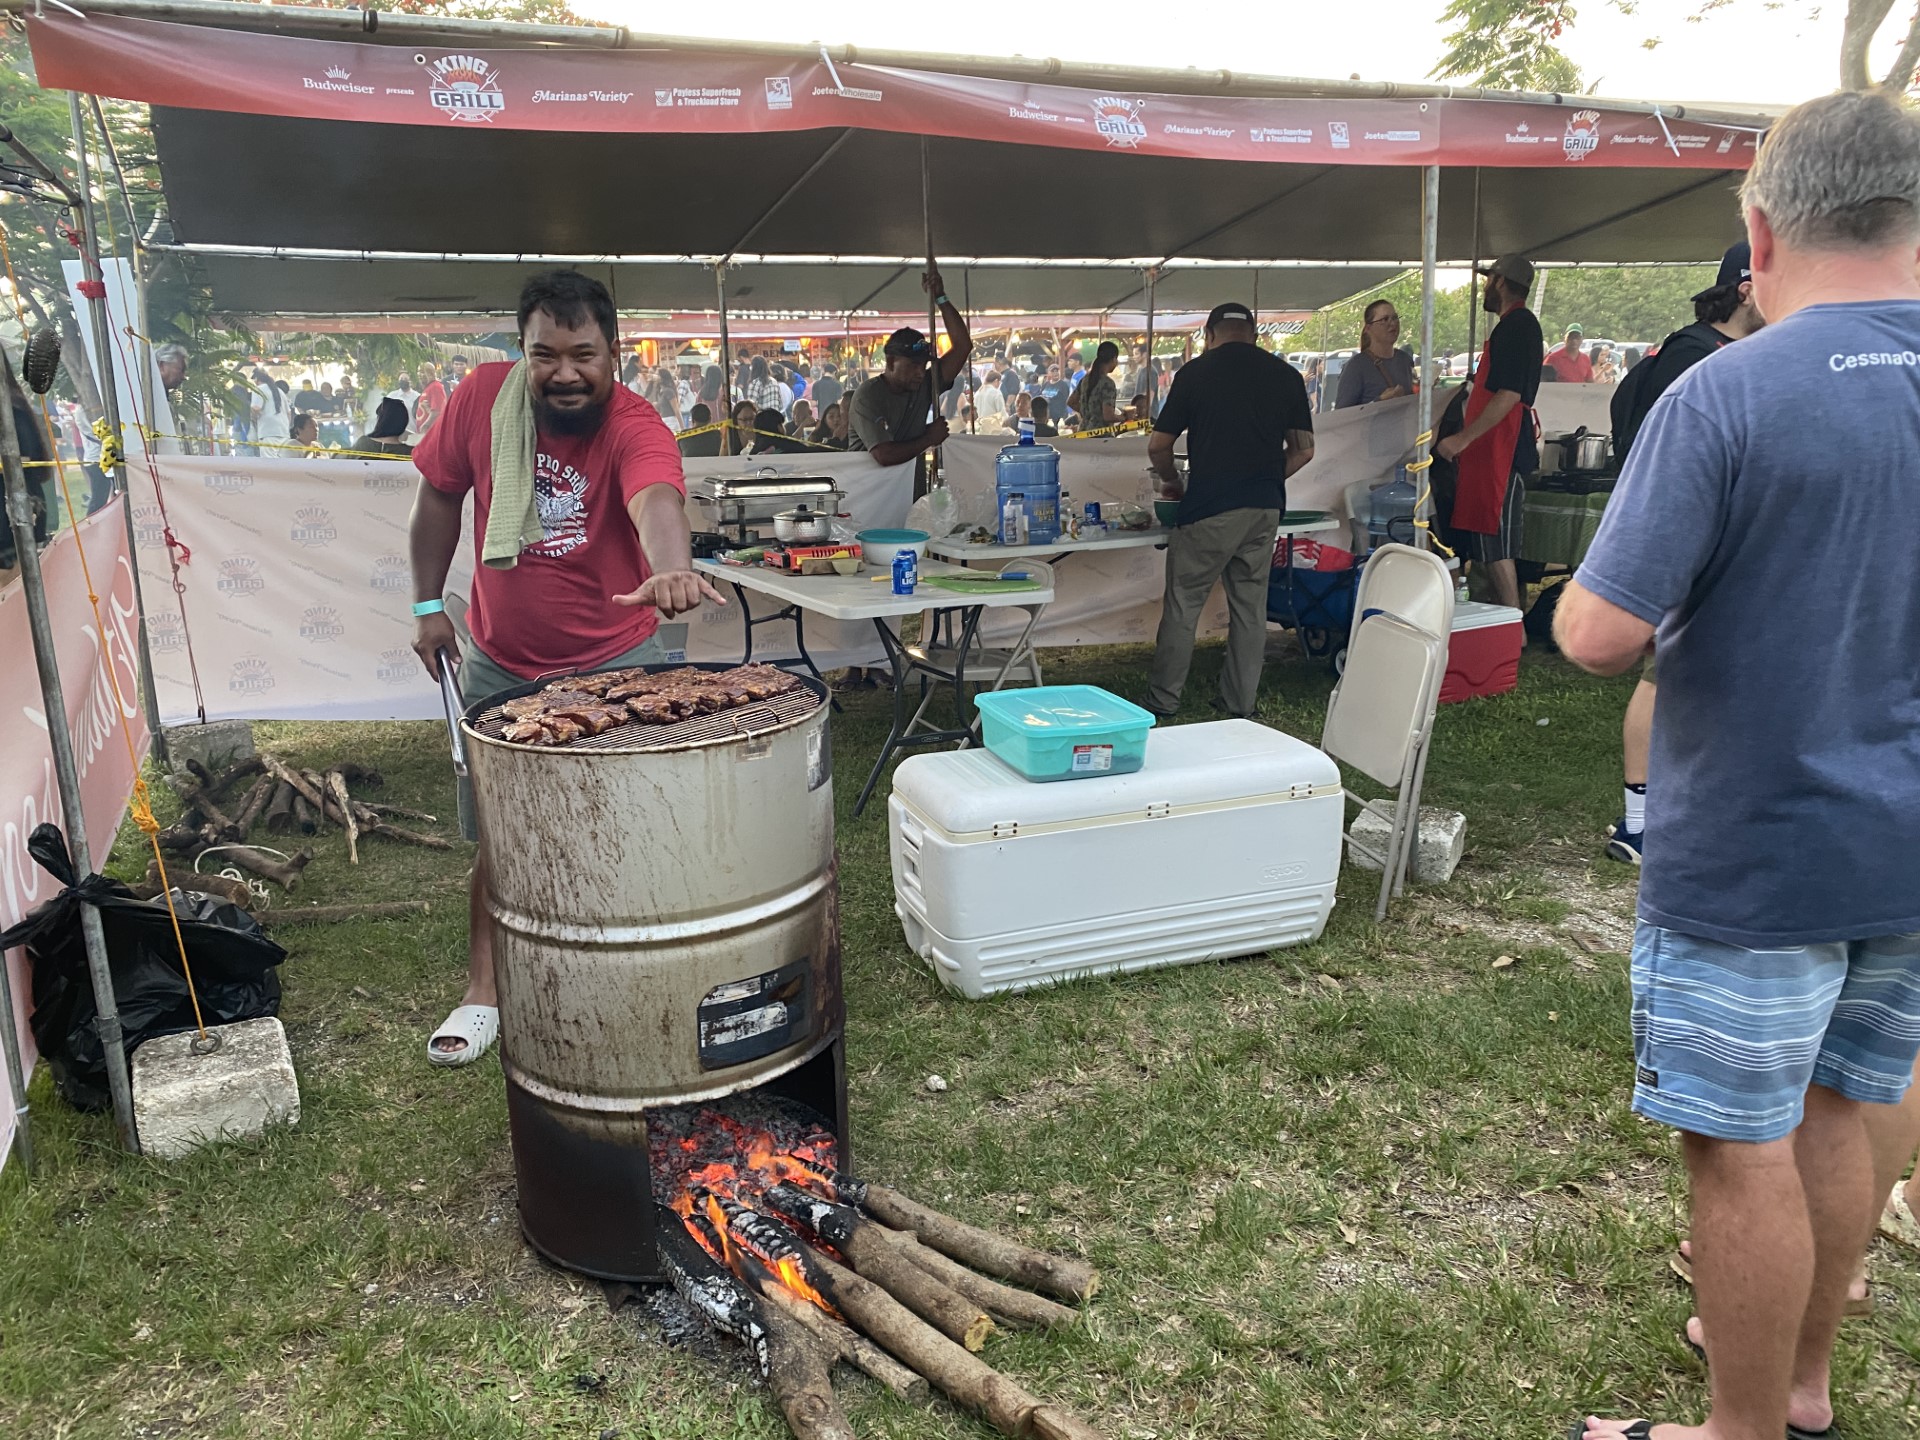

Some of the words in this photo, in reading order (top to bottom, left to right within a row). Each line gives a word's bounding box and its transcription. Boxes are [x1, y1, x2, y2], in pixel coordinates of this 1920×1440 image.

[433, 55, 488, 75] KING
[303, 77, 375, 95] Budweiser
[386, 87, 415, 95] presents
[673, 88, 700, 97] Payless
[812, 87, 839, 96] Joeten
[433, 92, 503, 109] GRILL
[532, 90, 588, 103] Marianas
[588, 90, 634, 104] Variety
[677, 98, 683, 106] &
[684, 98, 719, 106] Truckload
[720, 98, 739, 106] Store
[1092, 97, 1132, 112] KING
[1009, 107, 1059, 122] Budweiser
[1572, 110, 1601, 123] KING
[1098, 121, 1146, 136] GRILL
[1164, 124, 1204, 135] Marianas
[1203, 126, 1236, 138] Variety
[1564, 138, 1596, 150] GRILL
[1829, 350, 1920, 372] CessnaO
[536, 453, 560, 473] PRO
[543, 527, 586, 558] TRADITION
[905, 571, 913, 579] BU
